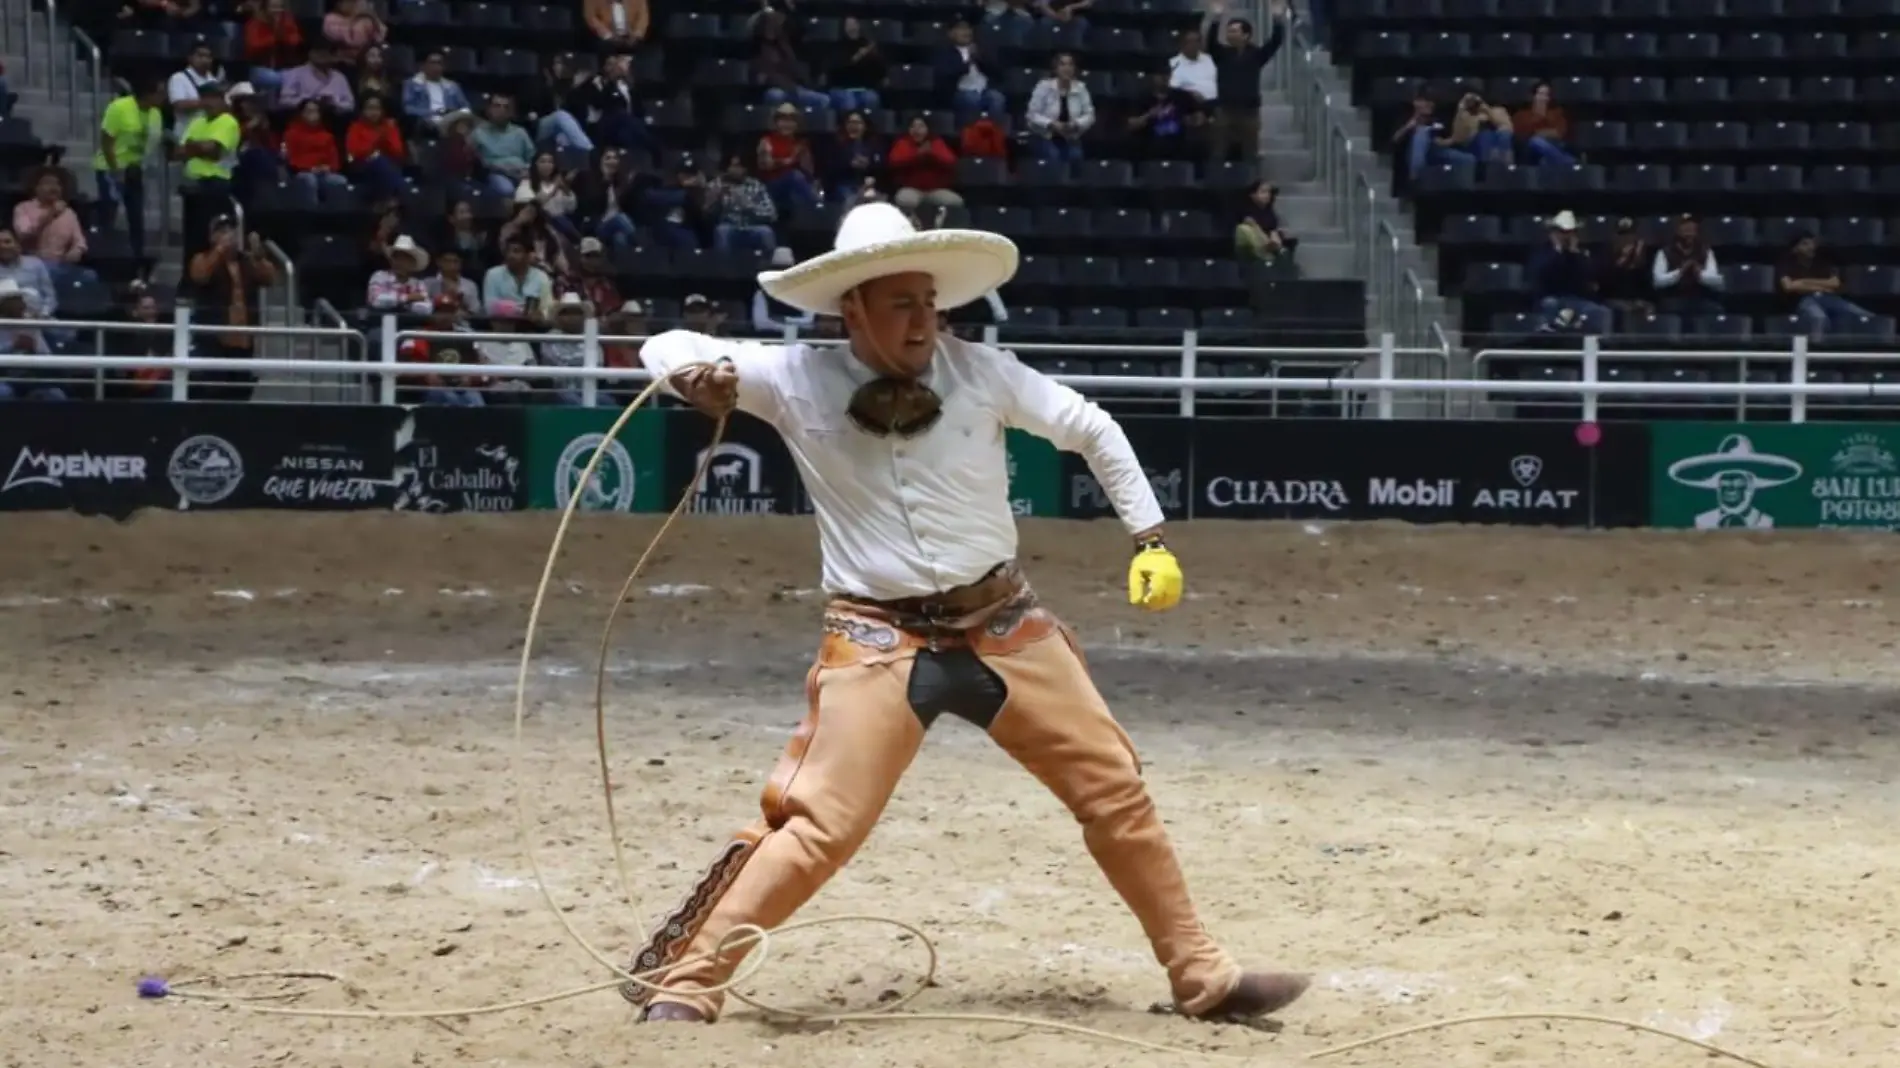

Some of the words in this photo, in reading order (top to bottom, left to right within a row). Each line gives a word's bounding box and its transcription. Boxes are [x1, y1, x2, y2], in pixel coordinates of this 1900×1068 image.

[281, 456, 363, 471] NISSAN
[263, 476, 304, 500] QUE
[428, 467, 502, 489] Caballo
[1811, 476, 1860, 498] SAN
[462, 492, 514, 511] Moro
[1207, 476, 1349, 510] CUADRA
[1368, 477, 1453, 505] Mobil
[1472, 488, 1578, 508] ARIAT
